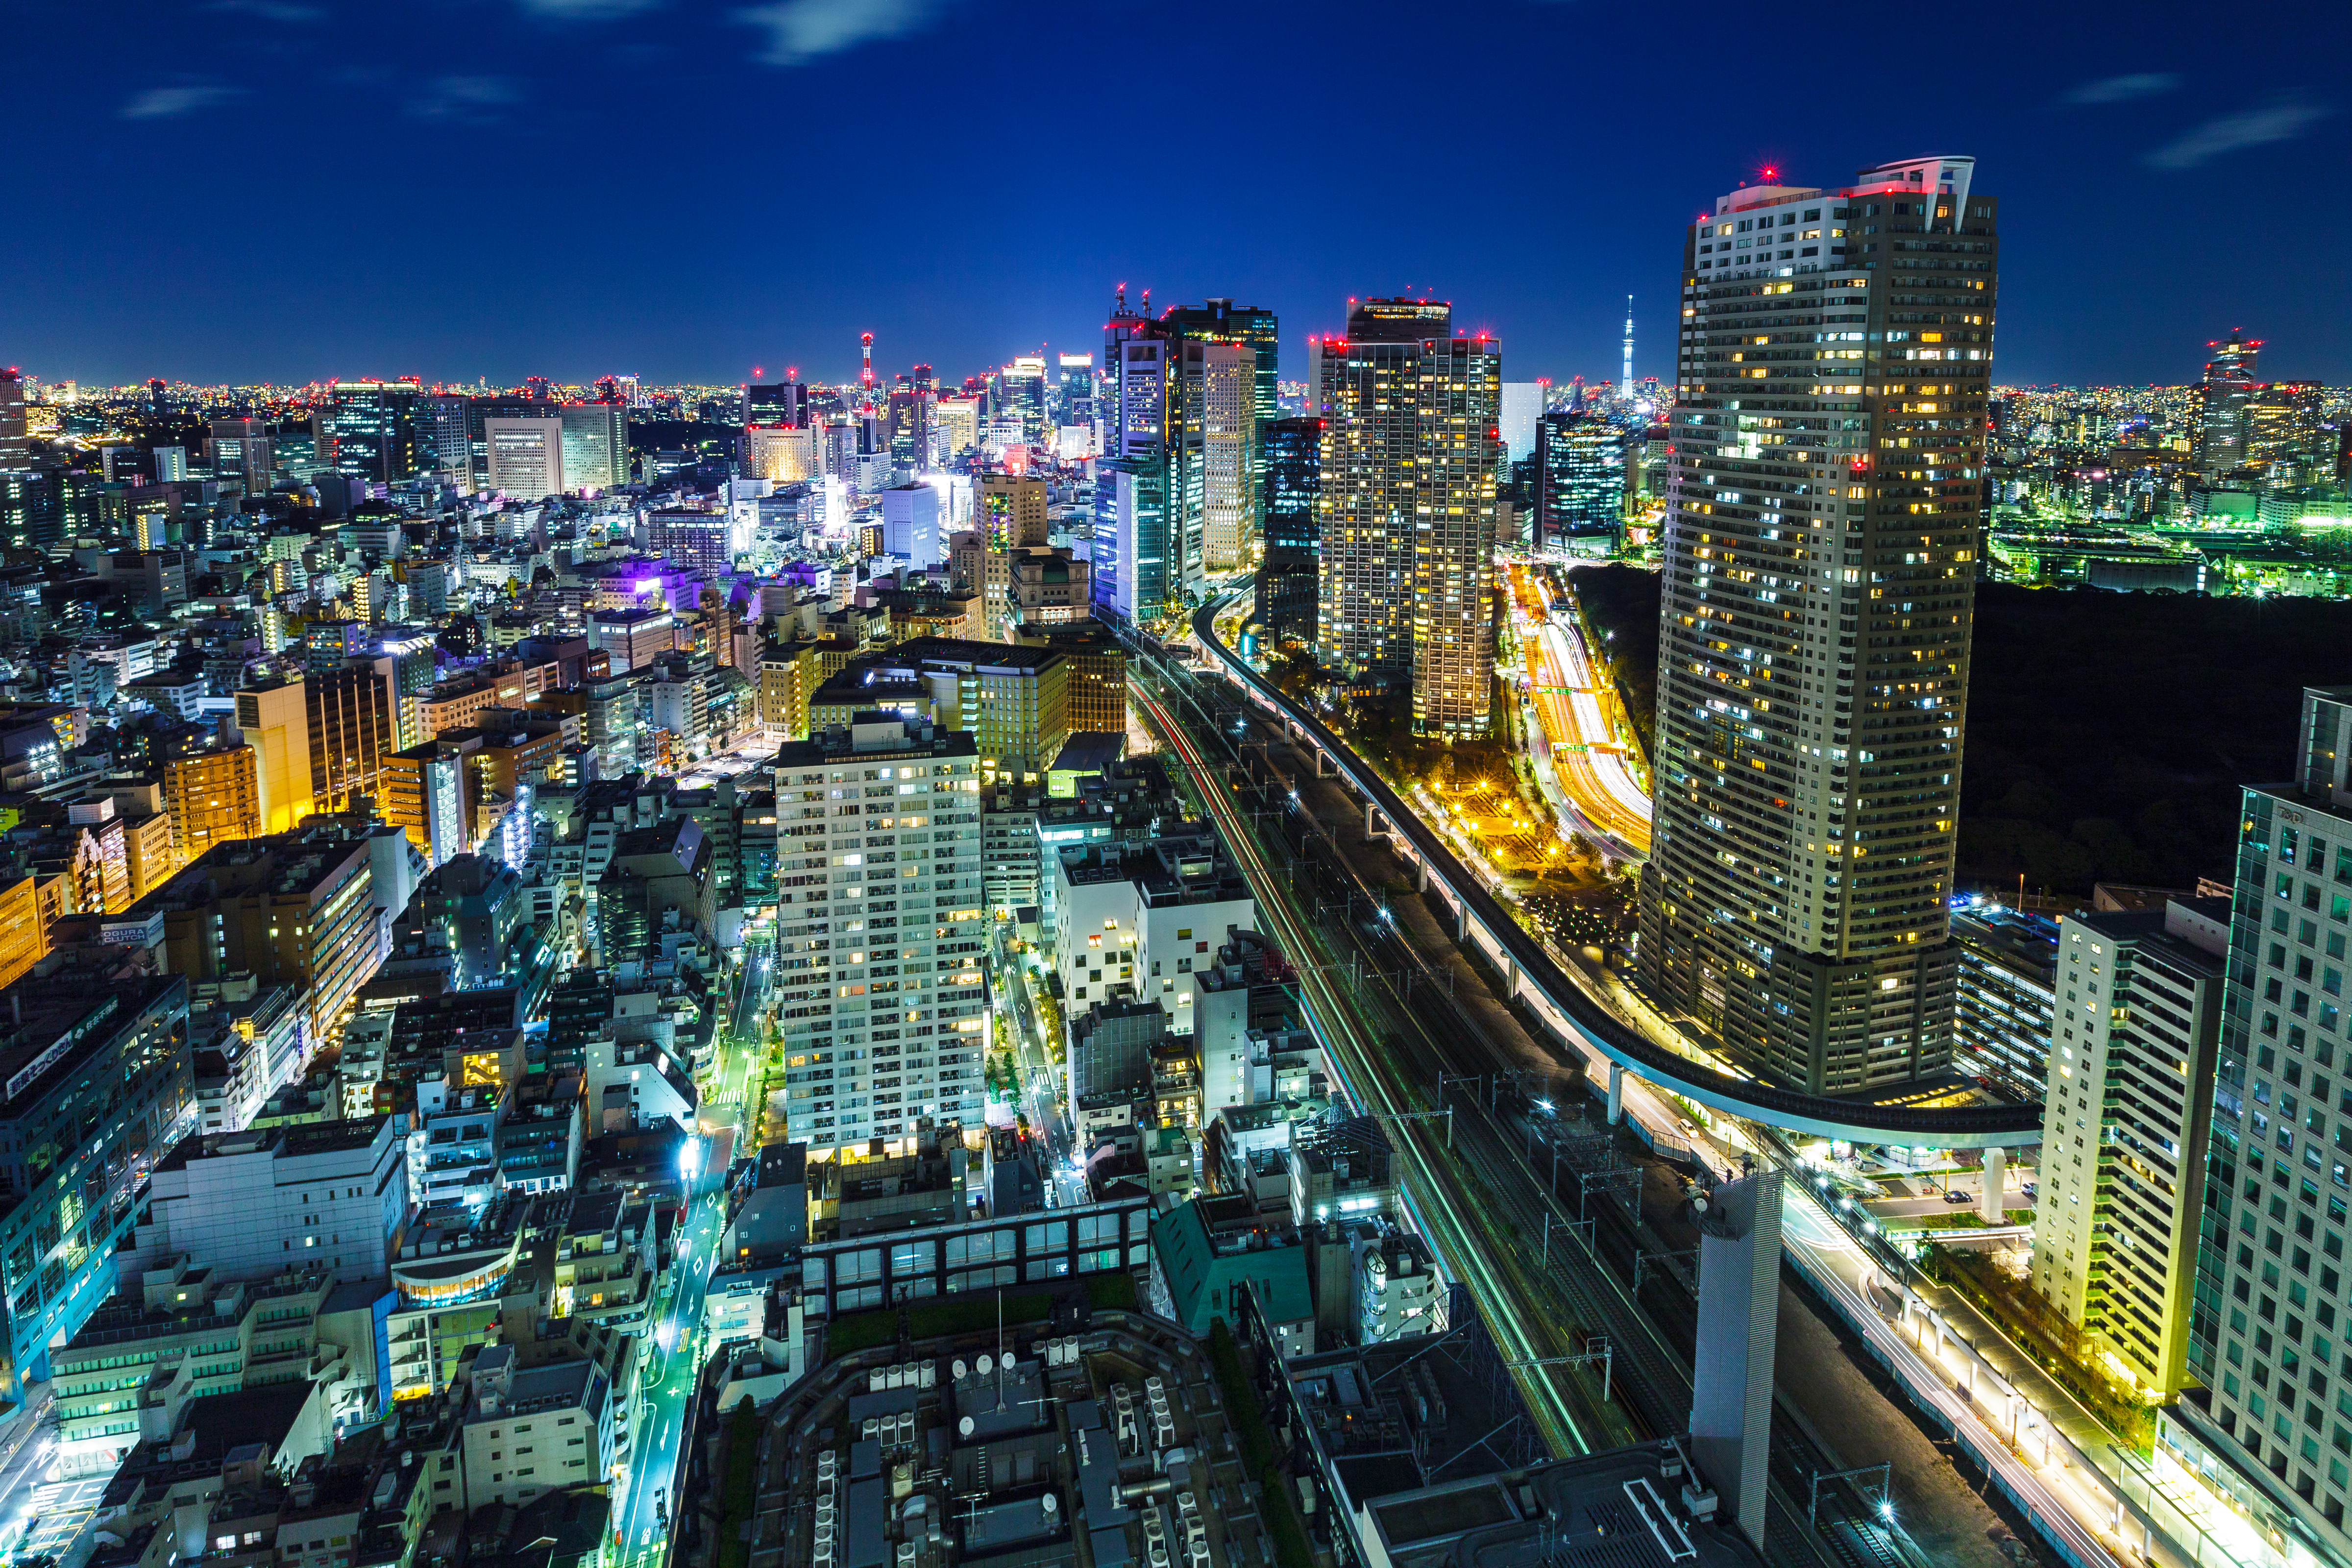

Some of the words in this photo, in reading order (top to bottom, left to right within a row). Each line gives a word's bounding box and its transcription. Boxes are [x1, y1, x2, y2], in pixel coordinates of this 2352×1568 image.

[10, 1037, 72, 1095] 新築そっくりさん
[677, 1327, 690, 1353] 30
[637, 1526, 651, 1568] 徐行
